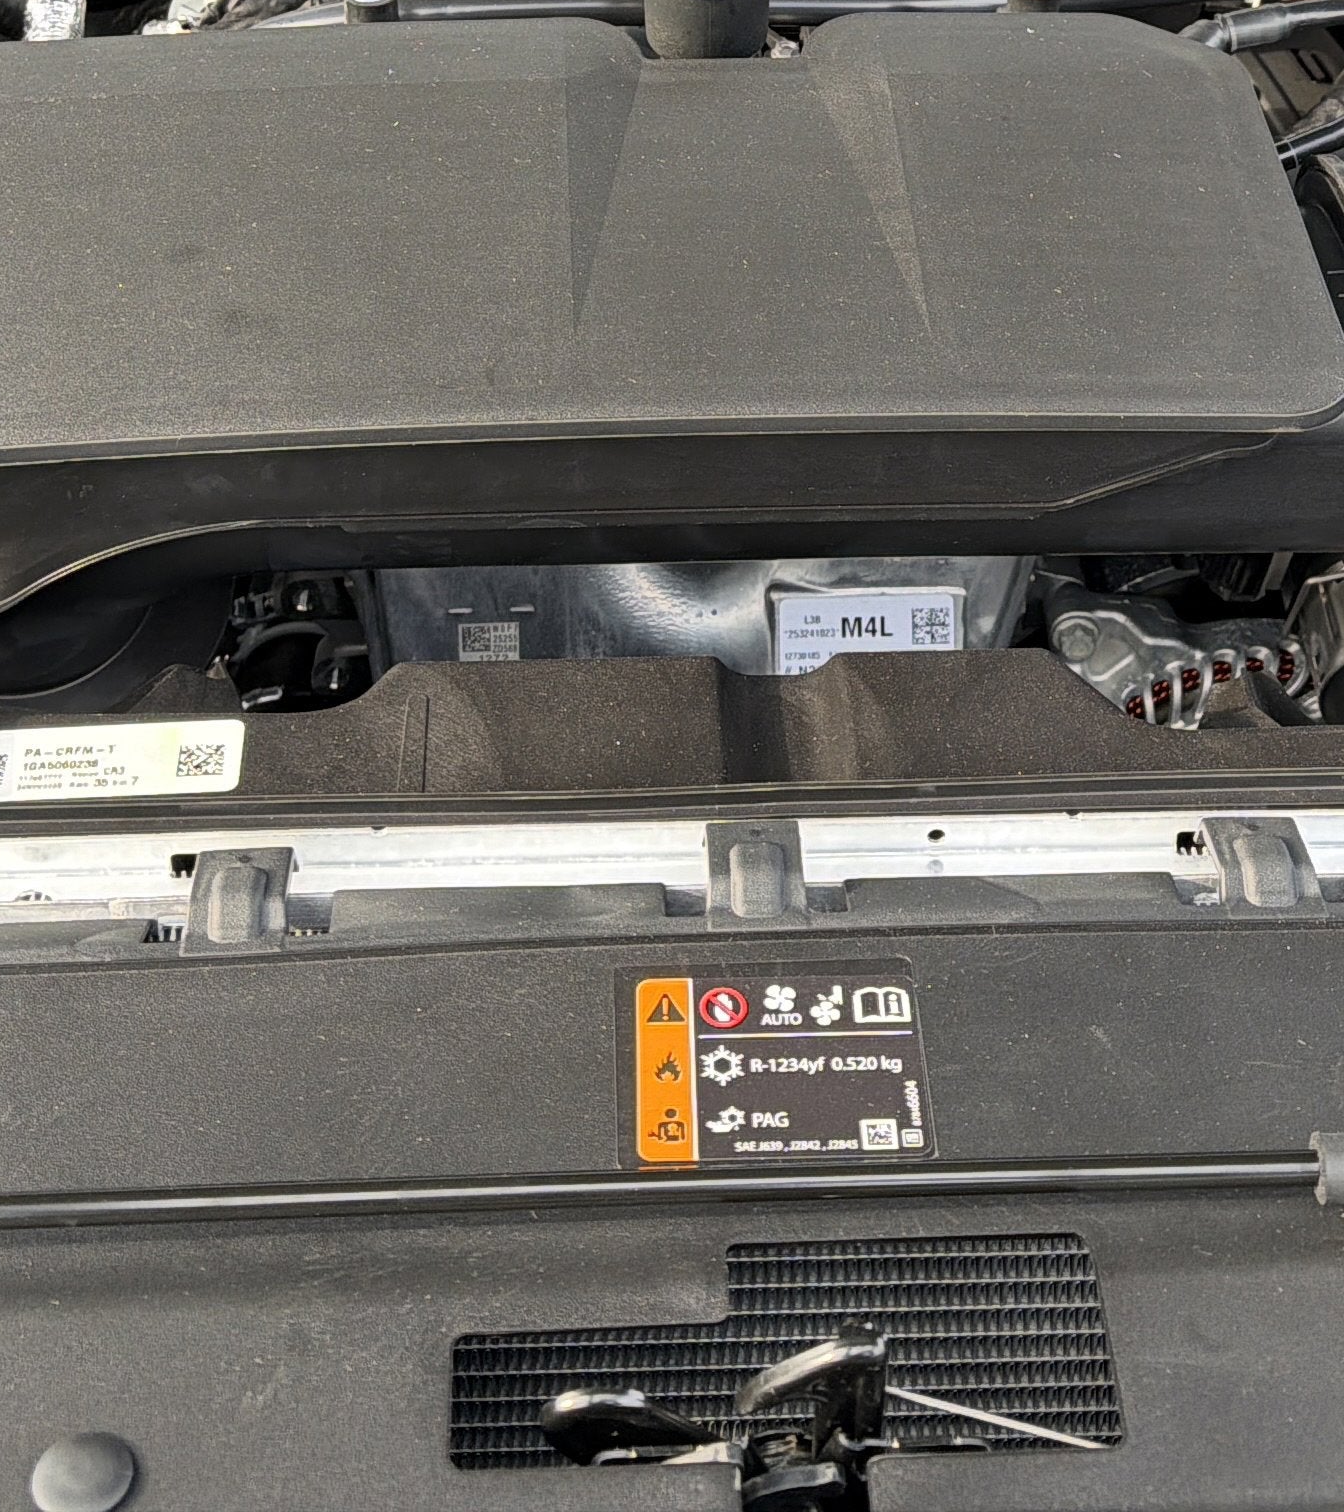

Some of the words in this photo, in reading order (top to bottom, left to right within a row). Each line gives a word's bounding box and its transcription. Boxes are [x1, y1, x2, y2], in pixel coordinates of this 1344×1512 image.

[841, 616, 894, 639] M4L
[761, 1013, 803, 1026] AUTO
[749, 1059, 826, 1074] R-1234yf
[831, 1058, 878, 1072] 0.520
[880, 1057, 903, 1074] kg
[751, 1112, 789, 1128] PAG
